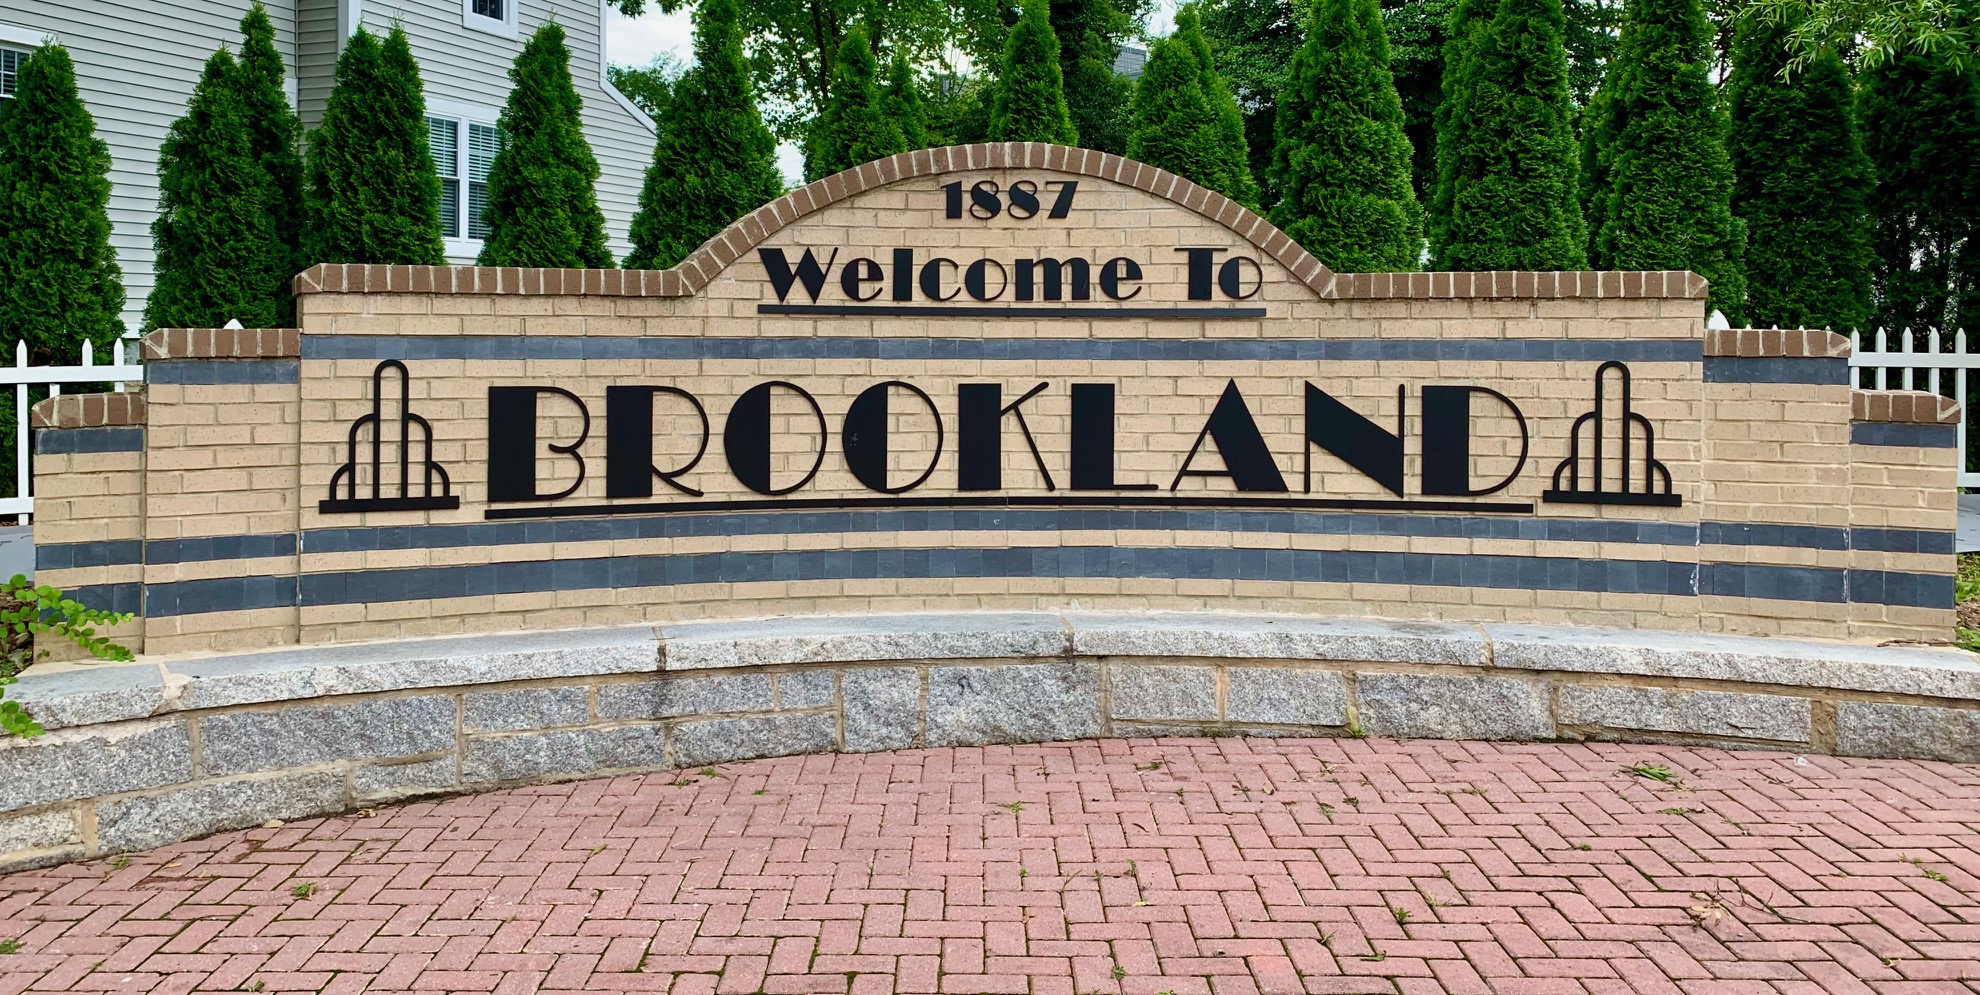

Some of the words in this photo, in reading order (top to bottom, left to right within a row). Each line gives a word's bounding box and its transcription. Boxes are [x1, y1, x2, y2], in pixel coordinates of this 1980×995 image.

[940, 180, 1079, 221] 1887
[757, 247, 1143, 304] Welcome
[1174, 247, 1263, 301] To
[487, 377, 1529, 503] BROOKLAND
